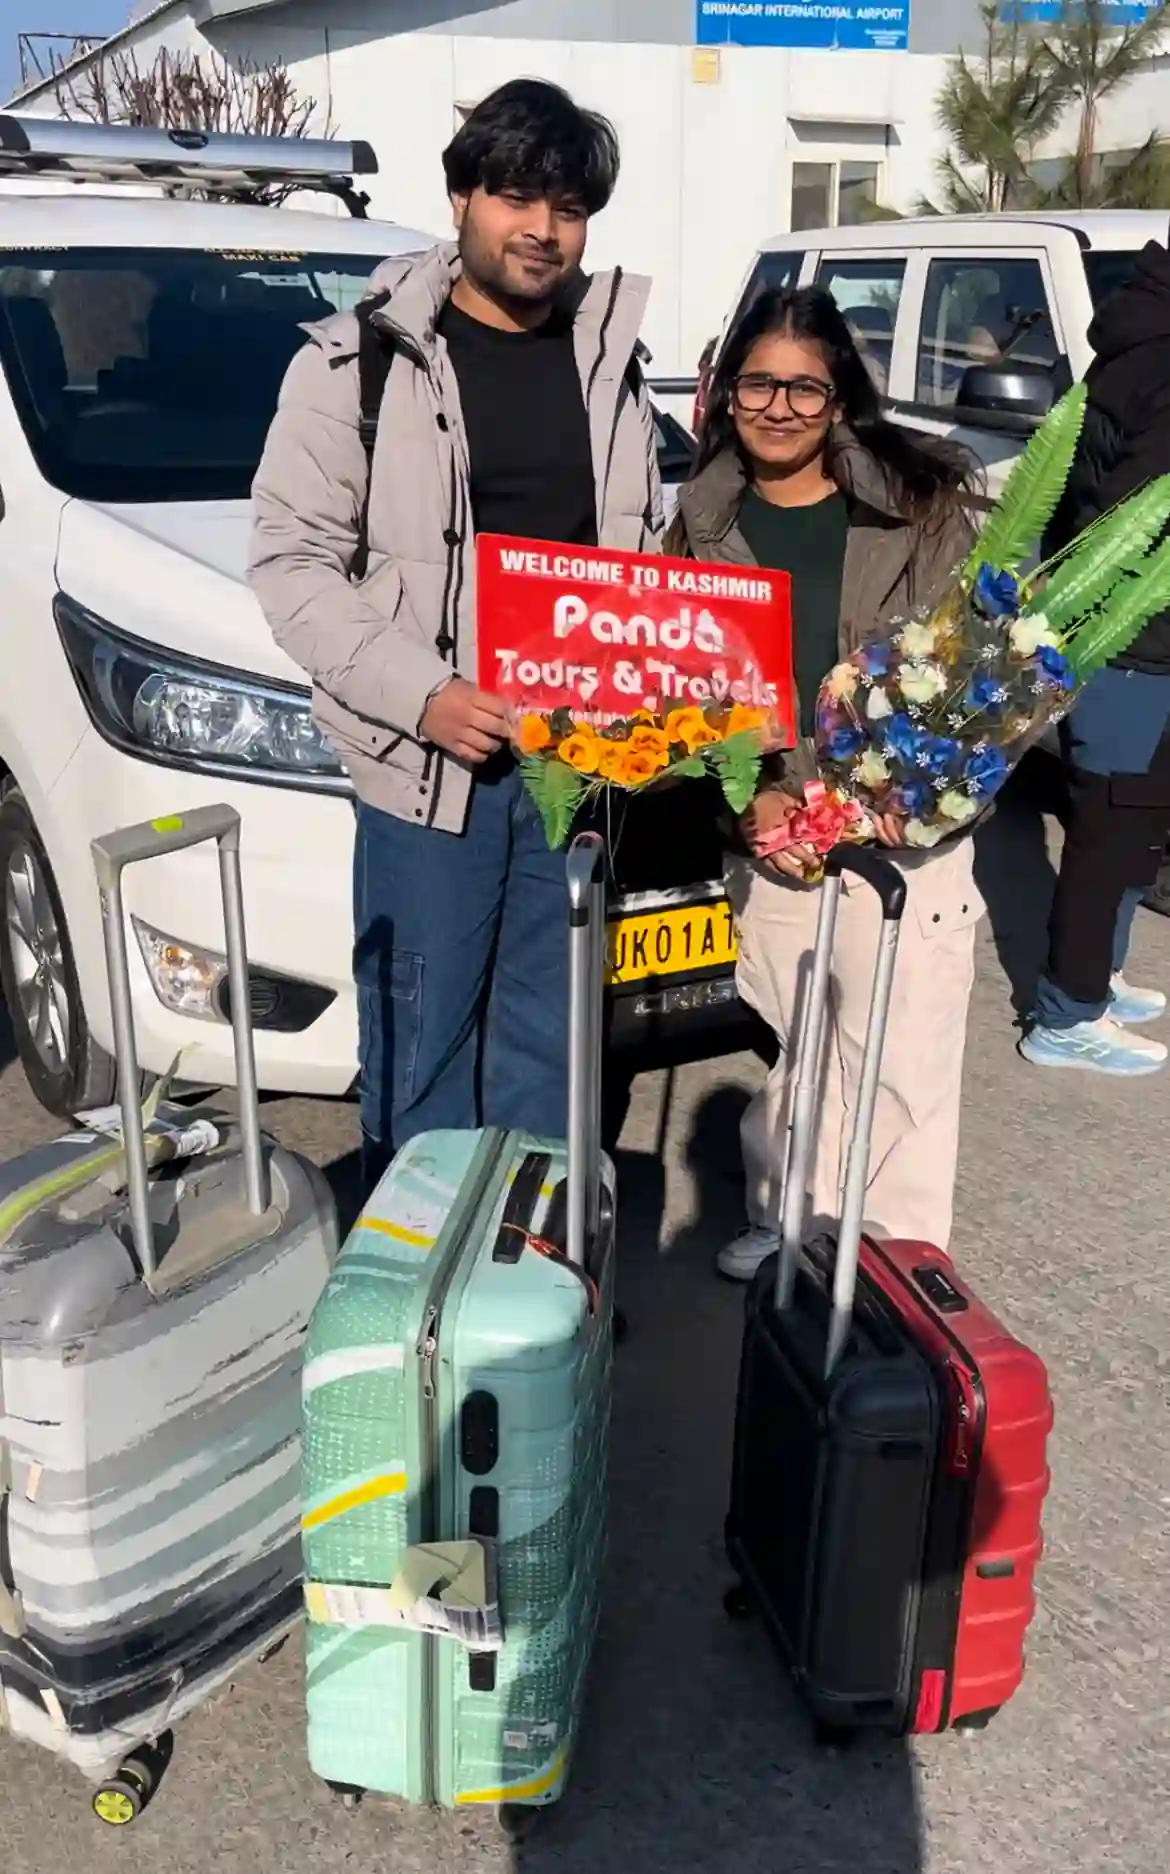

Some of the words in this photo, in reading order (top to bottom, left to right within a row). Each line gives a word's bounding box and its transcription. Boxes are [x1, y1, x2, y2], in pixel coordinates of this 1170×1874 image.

[702, 2, 763, 16] SRINAGAR
[765, 4, 852, 19] INTERNATIONAL
[856, 8, 904, 20] AIRPORT
[499, 549, 625, 583] WELCOME
[631, 565, 659, 588] TO
[667, 569, 773, 601] KASHMIR
[553, 595, 724, 653] Panda
[495, 649, 598, 700] Tours
[613, 660, 643, 695] &
